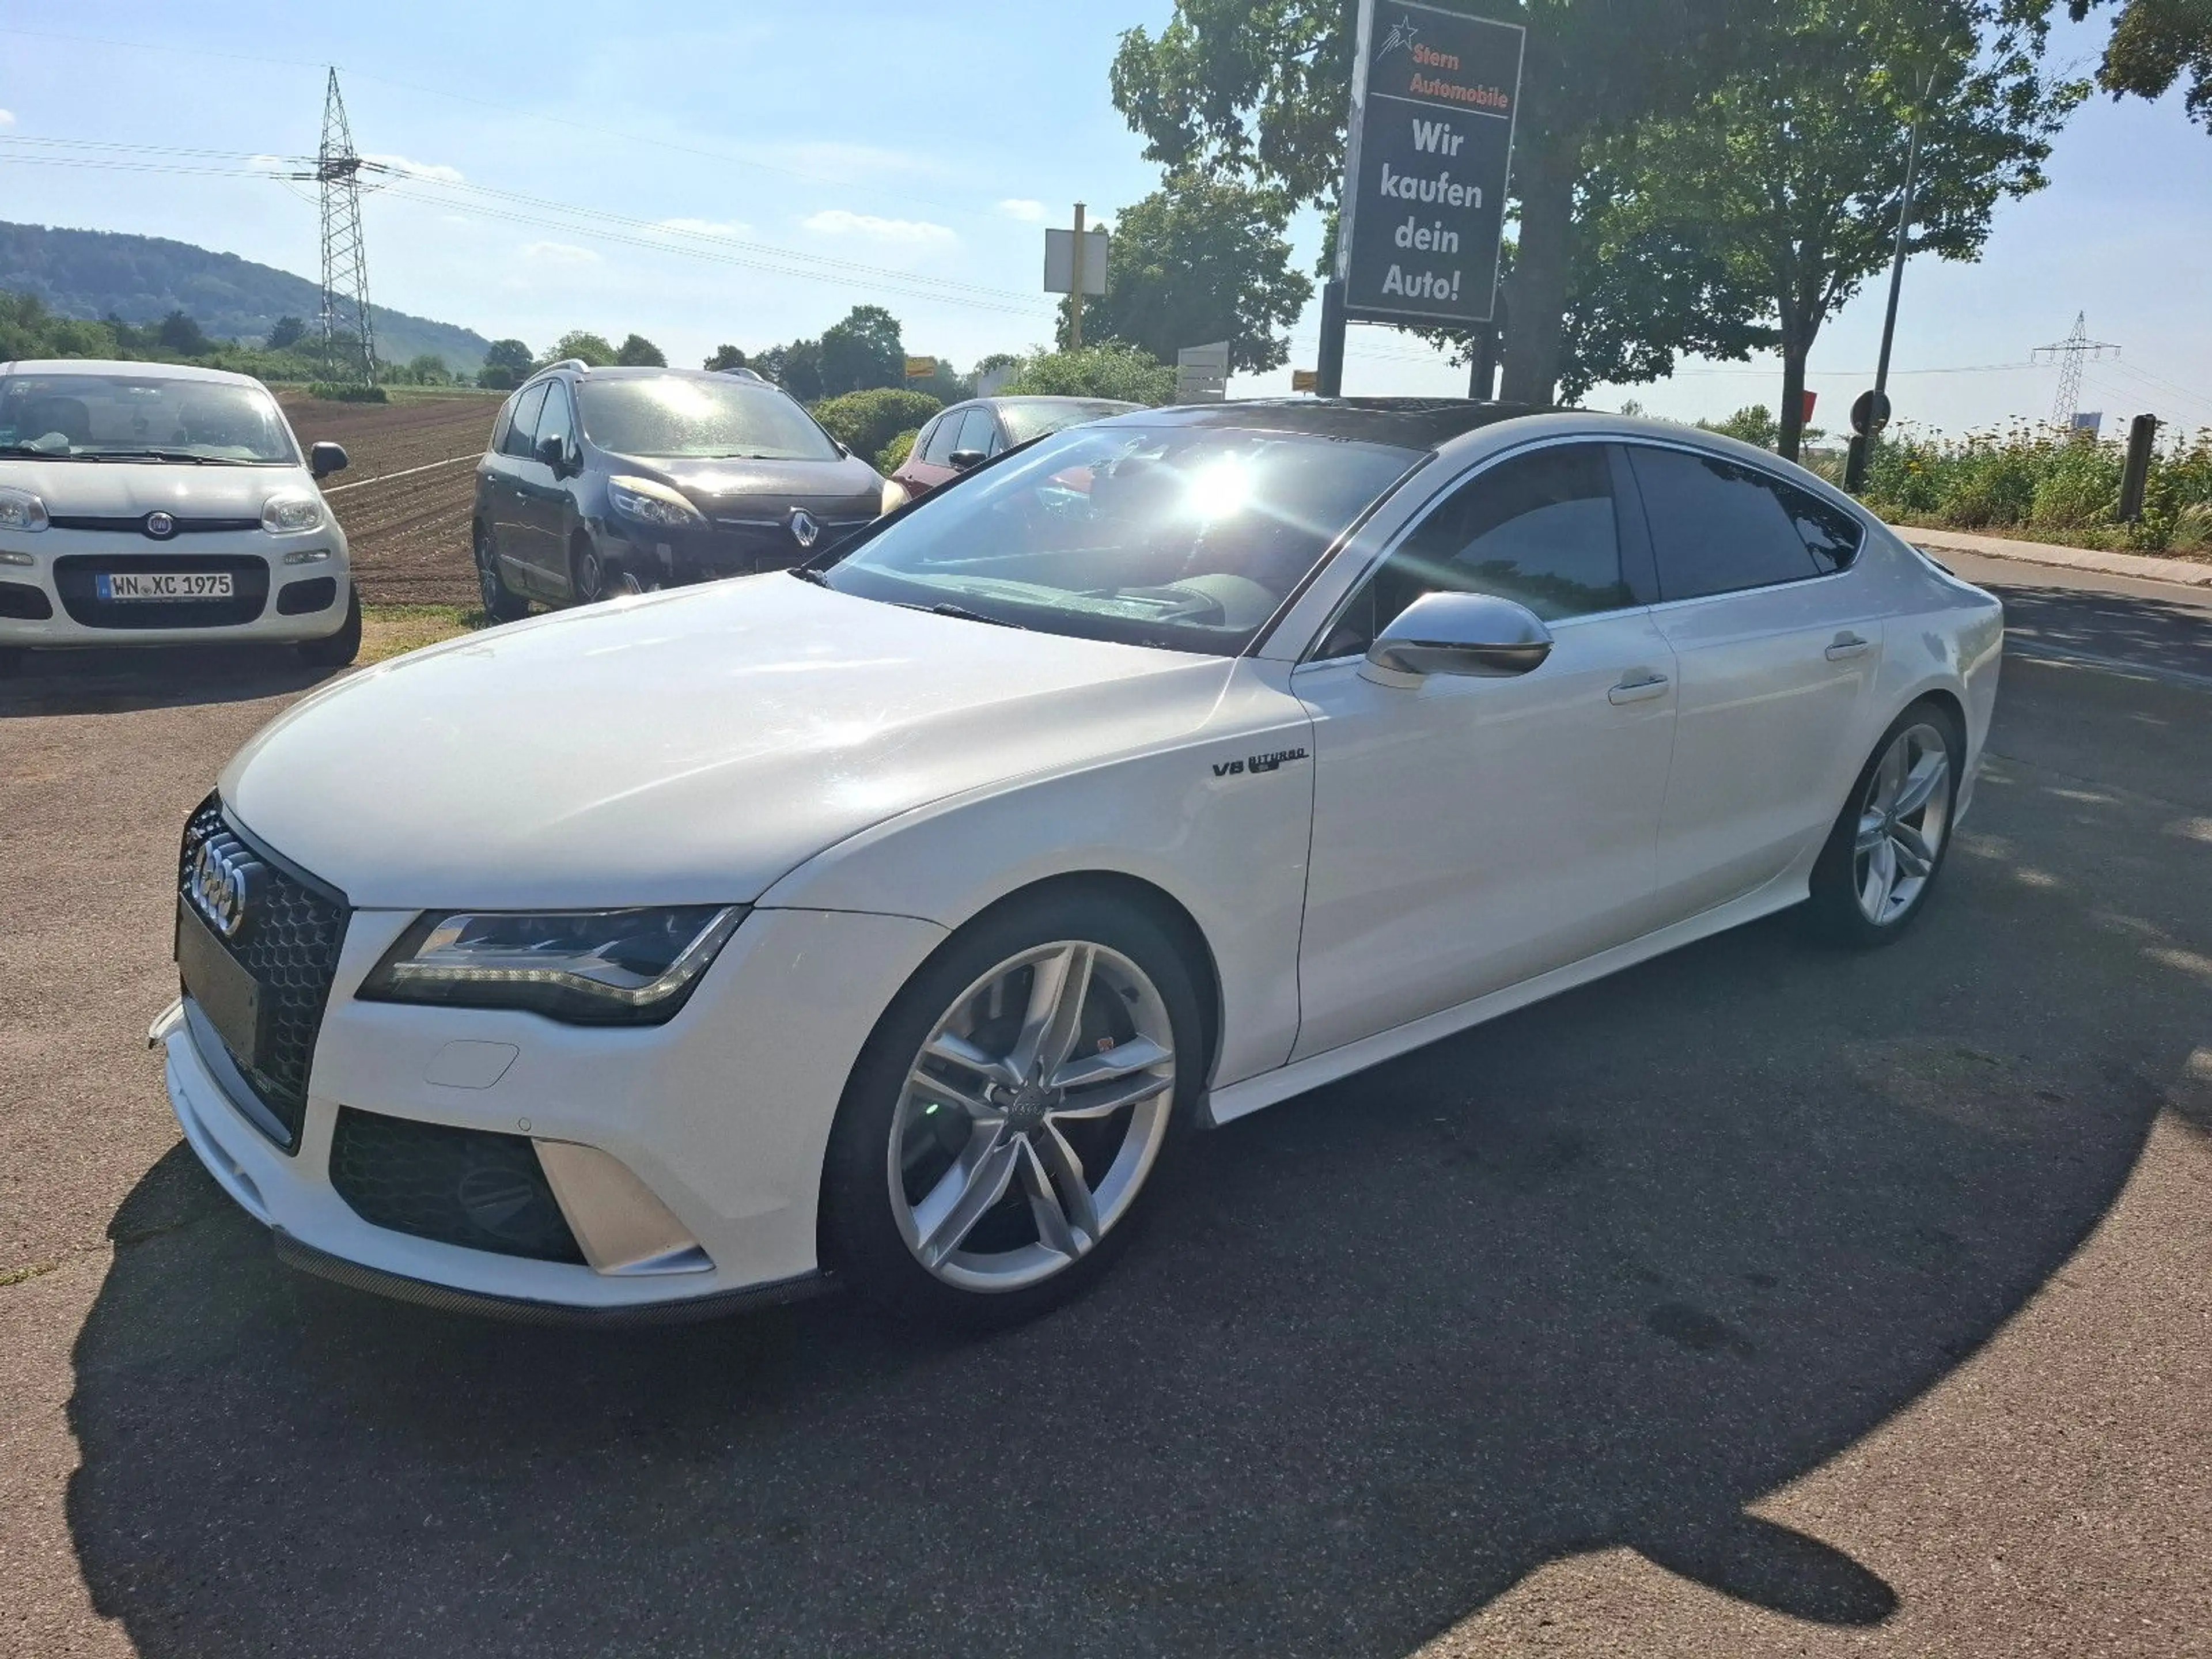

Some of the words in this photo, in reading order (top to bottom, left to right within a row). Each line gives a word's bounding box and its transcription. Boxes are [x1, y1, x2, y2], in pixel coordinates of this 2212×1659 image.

[1413, 43, 1460, 71] Stern
[1410, 73, 1508, 109] Automobile
[1412, 119, 1464, 156] Wir
[1381, 163, 1482, 209] kaufen
[1395, 215, 1459, 253] dein
[1382, 264, 1461, 301] Auto!
[113, 577, 138, 595] WN
[152, 577, 176, 594] XC
[182, 575, 230, 594] 1975
[1213, 760, 1244, 777] V8
